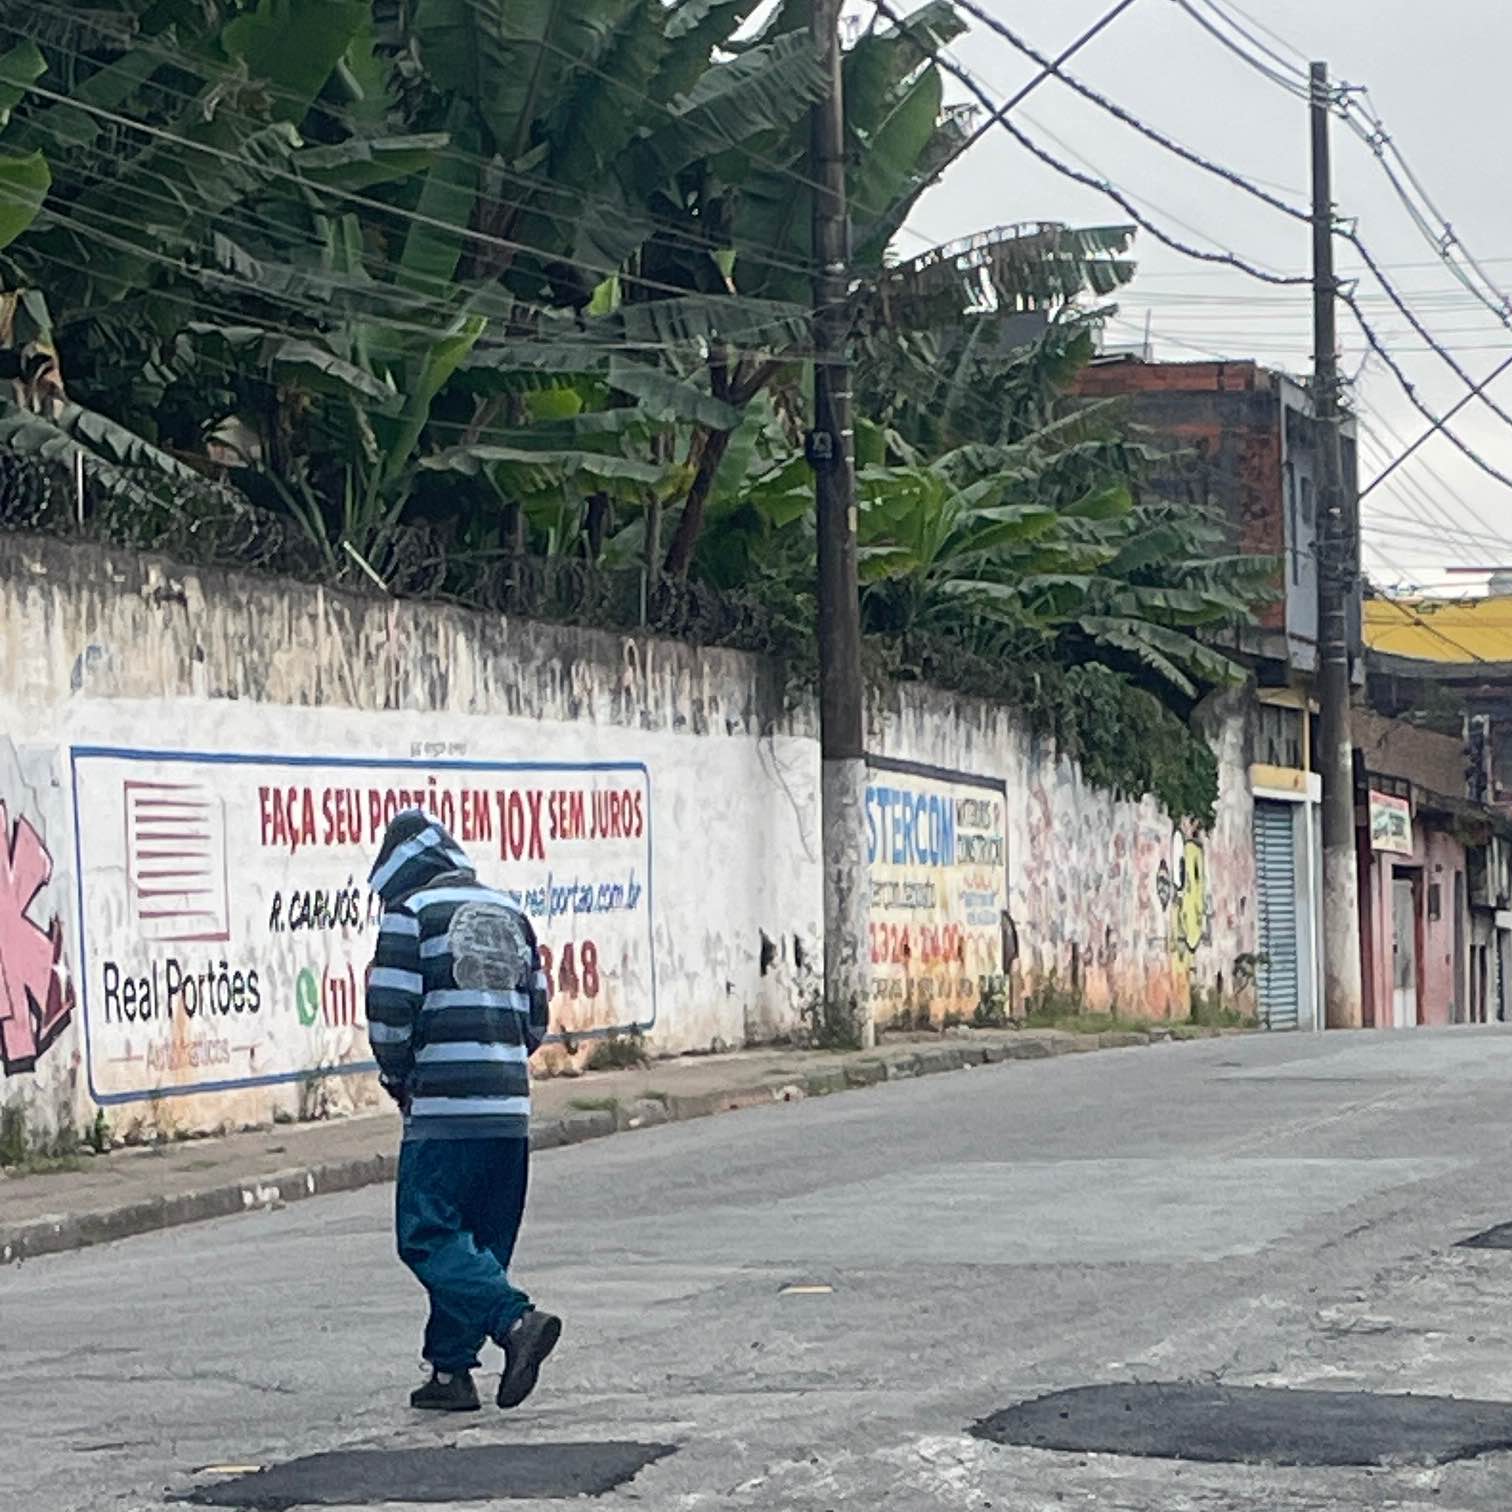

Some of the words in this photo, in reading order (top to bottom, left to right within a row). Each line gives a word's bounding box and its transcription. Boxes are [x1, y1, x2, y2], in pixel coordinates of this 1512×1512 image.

[259, 786, 316, 854] FAÇA
[322, 788, 361, 845] SEU
[461, 789, 492, 841] EM
[496, 789, 545, 861] 10X
[549, 790, 586, 840] SEM
[590, 789, 643, 839] JUROS
[269, 890, 285, 932] R.
[103, 960, 158, 1023] Real
[166, 958, 261, 1019] Portões
